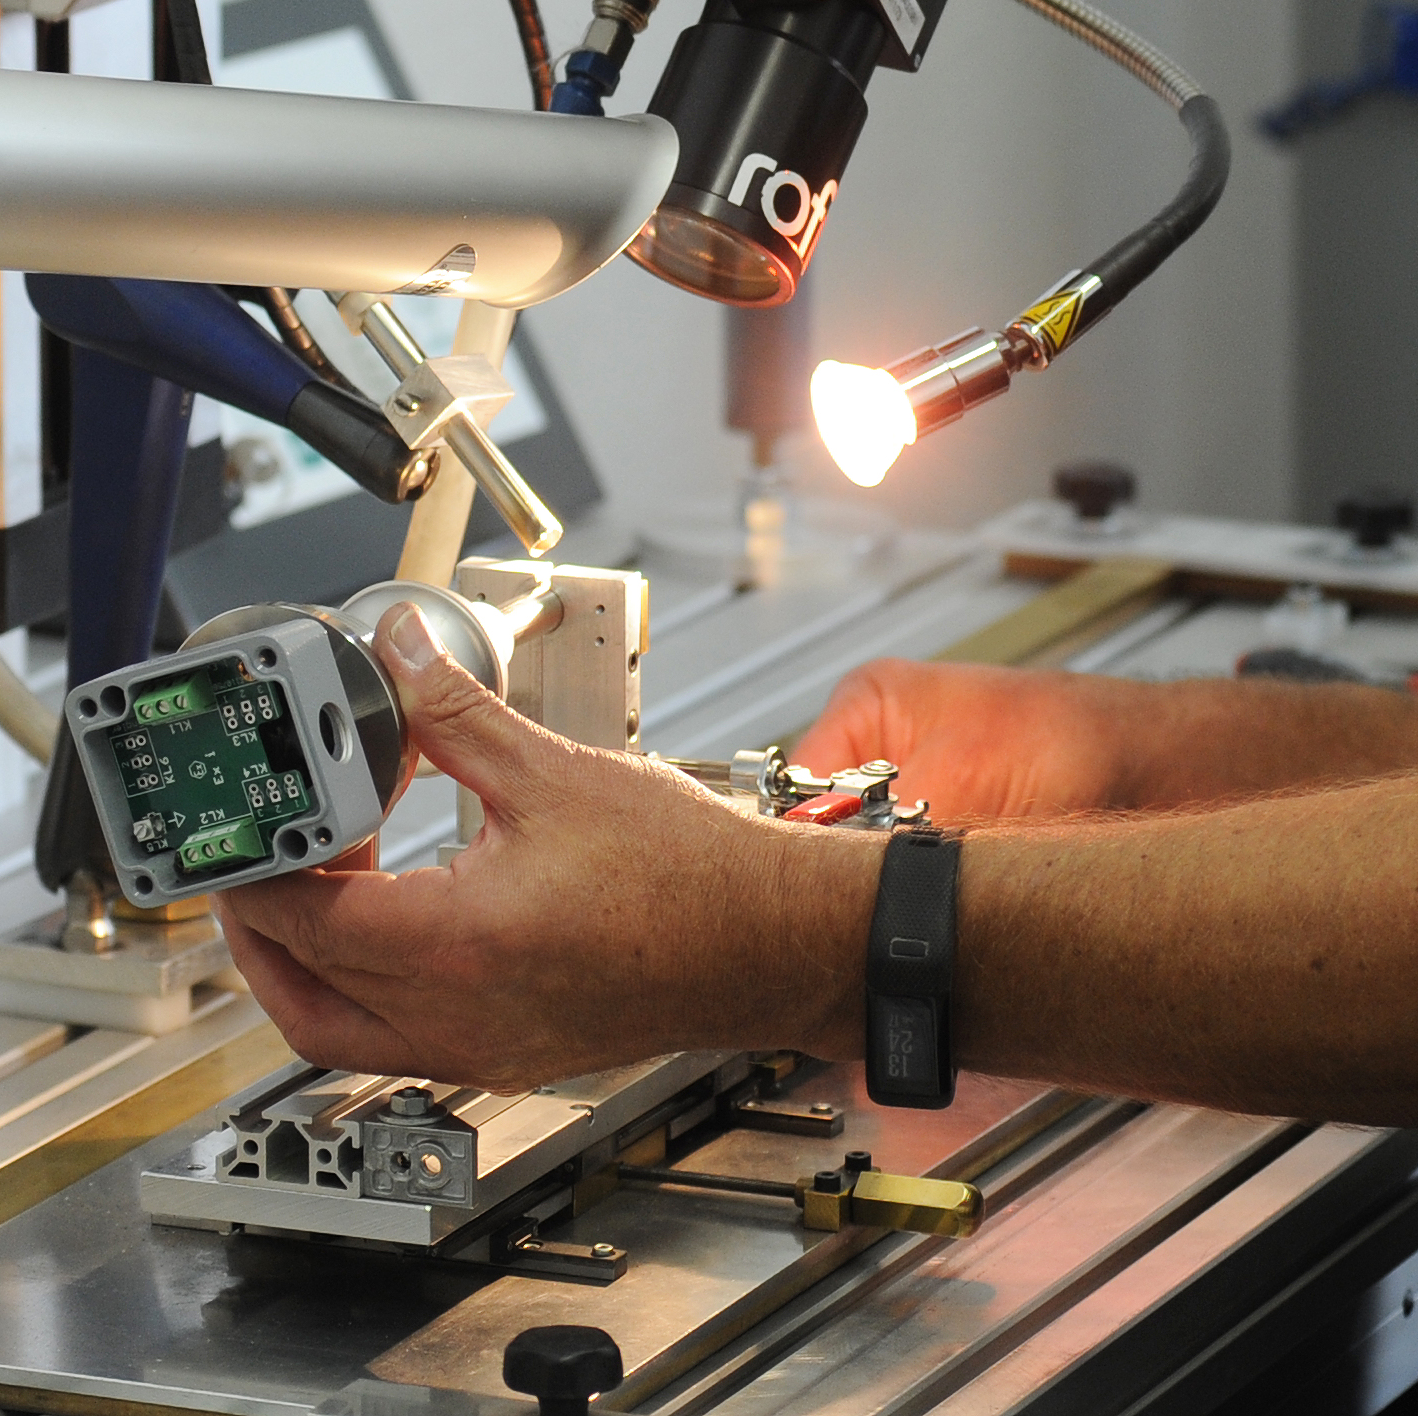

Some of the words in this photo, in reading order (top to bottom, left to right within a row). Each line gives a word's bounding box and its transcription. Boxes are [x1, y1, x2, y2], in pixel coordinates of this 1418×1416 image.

[168, 719, 192, 734] KL1
[231, 730, 257, 746] KL3
[159, 755, 175, 783] KL6
[242, 762, 267, 777] KL4
[198, 807, 224, 823] KL2
[146, 837, 168, 851] KL5
[888, 1029, 912, 1053] 24
[888, 1054, 908, 1078] 13
